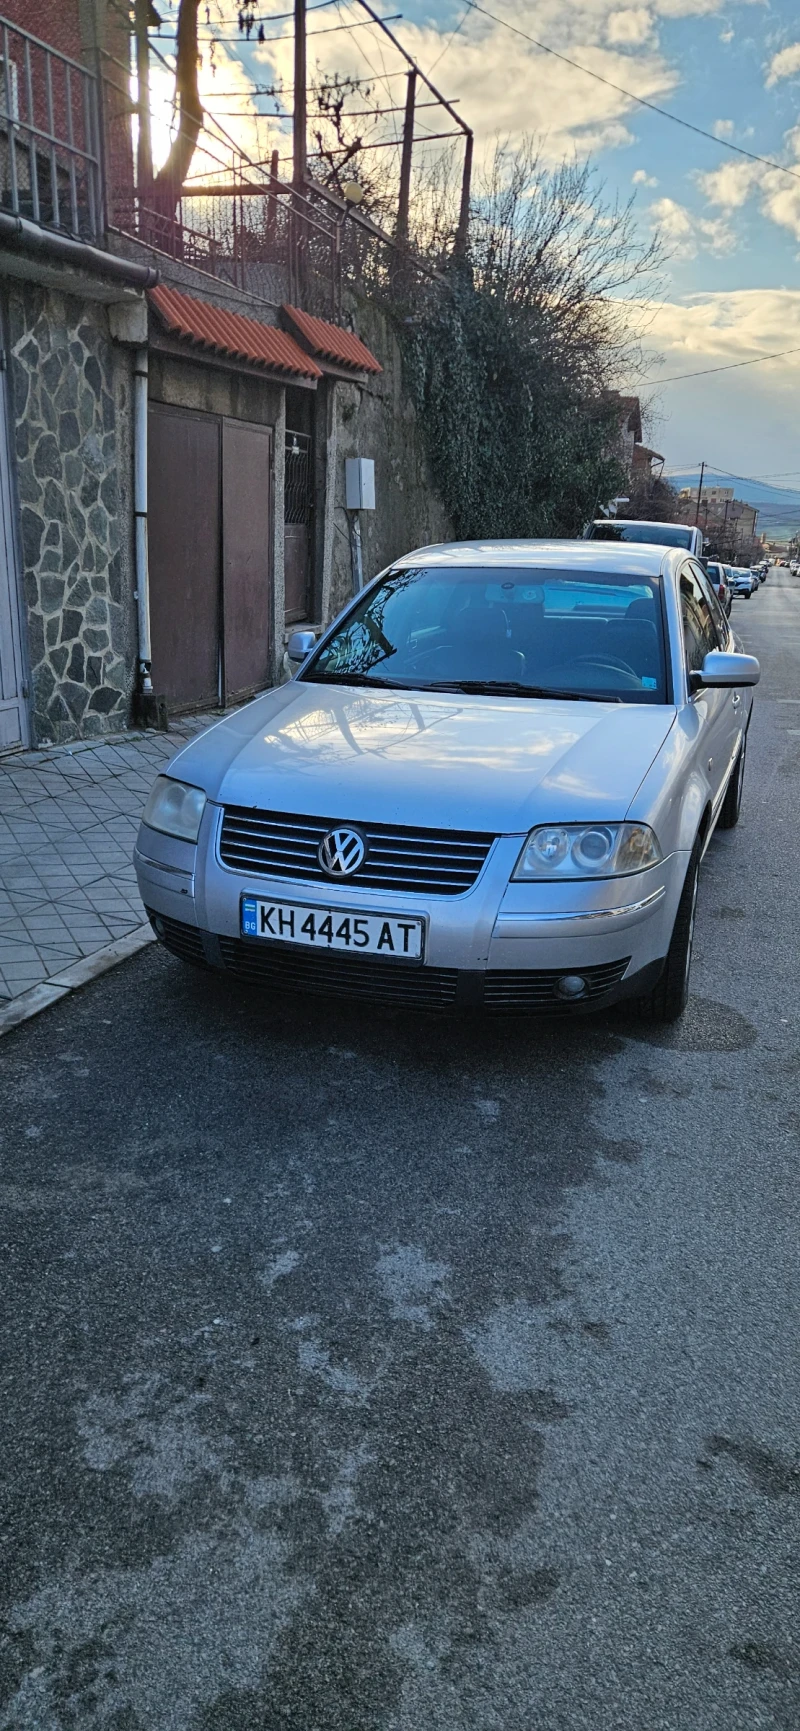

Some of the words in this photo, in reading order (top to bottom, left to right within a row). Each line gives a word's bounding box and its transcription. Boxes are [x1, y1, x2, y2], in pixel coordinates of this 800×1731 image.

[319, 829, 364, 875] VW
[244, 921, 256, 930] BG
[260, 905, 295, 937] KH
[301, 913, 370, 947] 4445
[377, 922, 416, 952] AT
